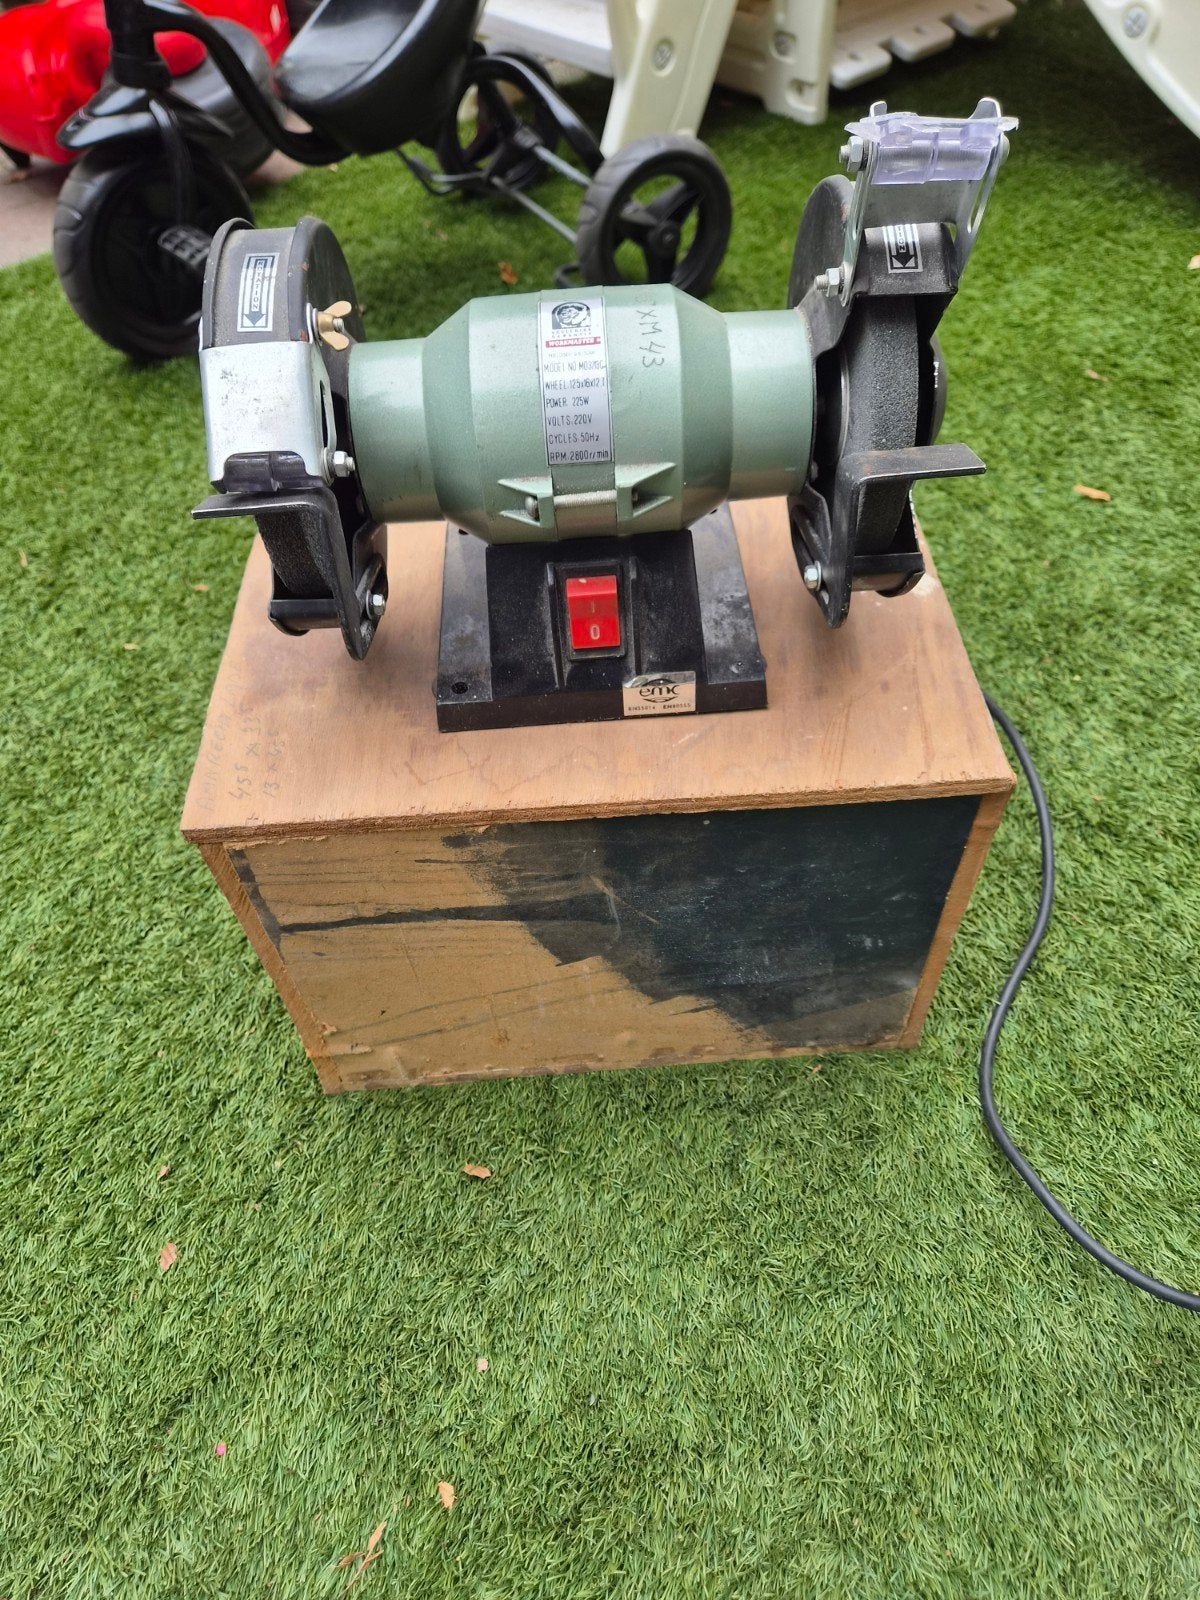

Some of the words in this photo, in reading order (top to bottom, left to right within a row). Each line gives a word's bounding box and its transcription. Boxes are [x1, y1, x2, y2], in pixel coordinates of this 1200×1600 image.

[252, 260, 263, 310] ROTATION
[549, 336, 595, 347] WORKMASTER
[573, 395, 590, 406] 225W
